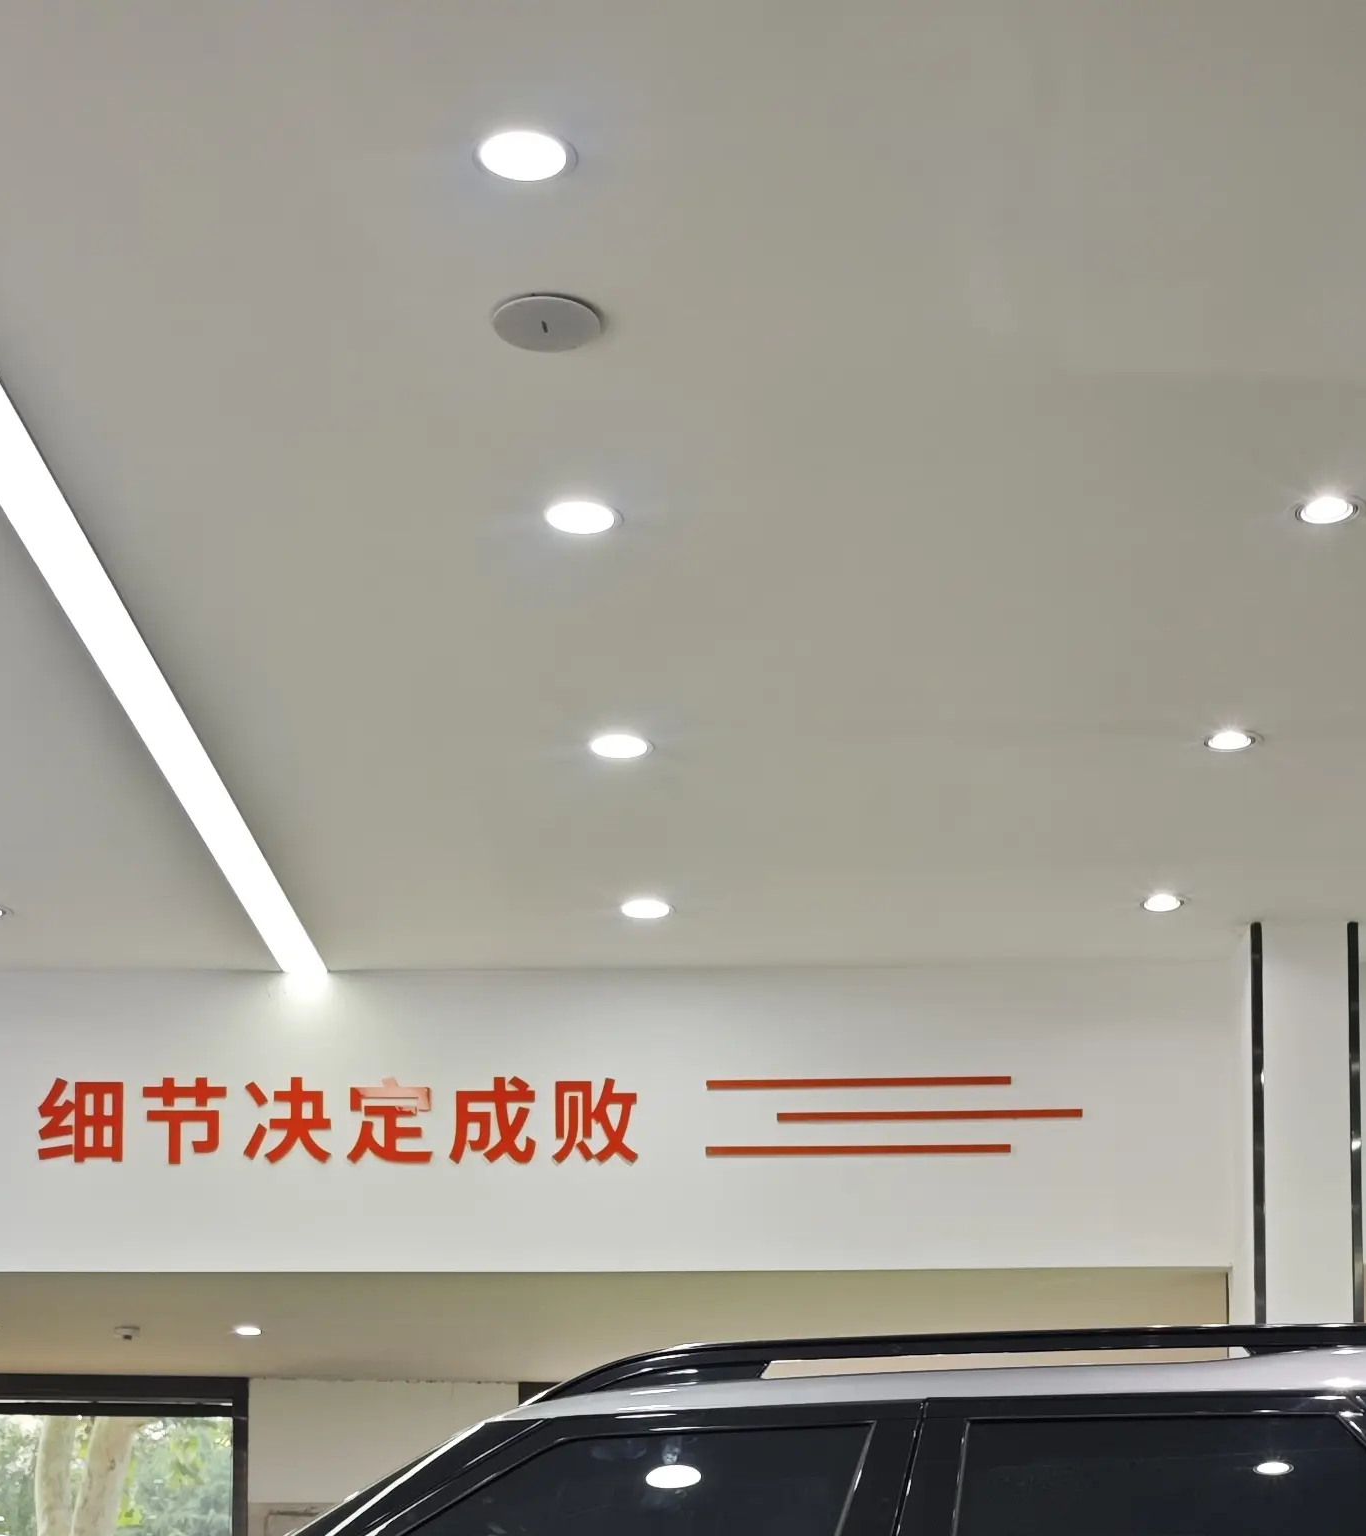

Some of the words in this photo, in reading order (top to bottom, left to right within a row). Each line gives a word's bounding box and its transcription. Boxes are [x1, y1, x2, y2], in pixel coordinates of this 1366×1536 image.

[37, 1076, 638, 1165] 细节决定成败
